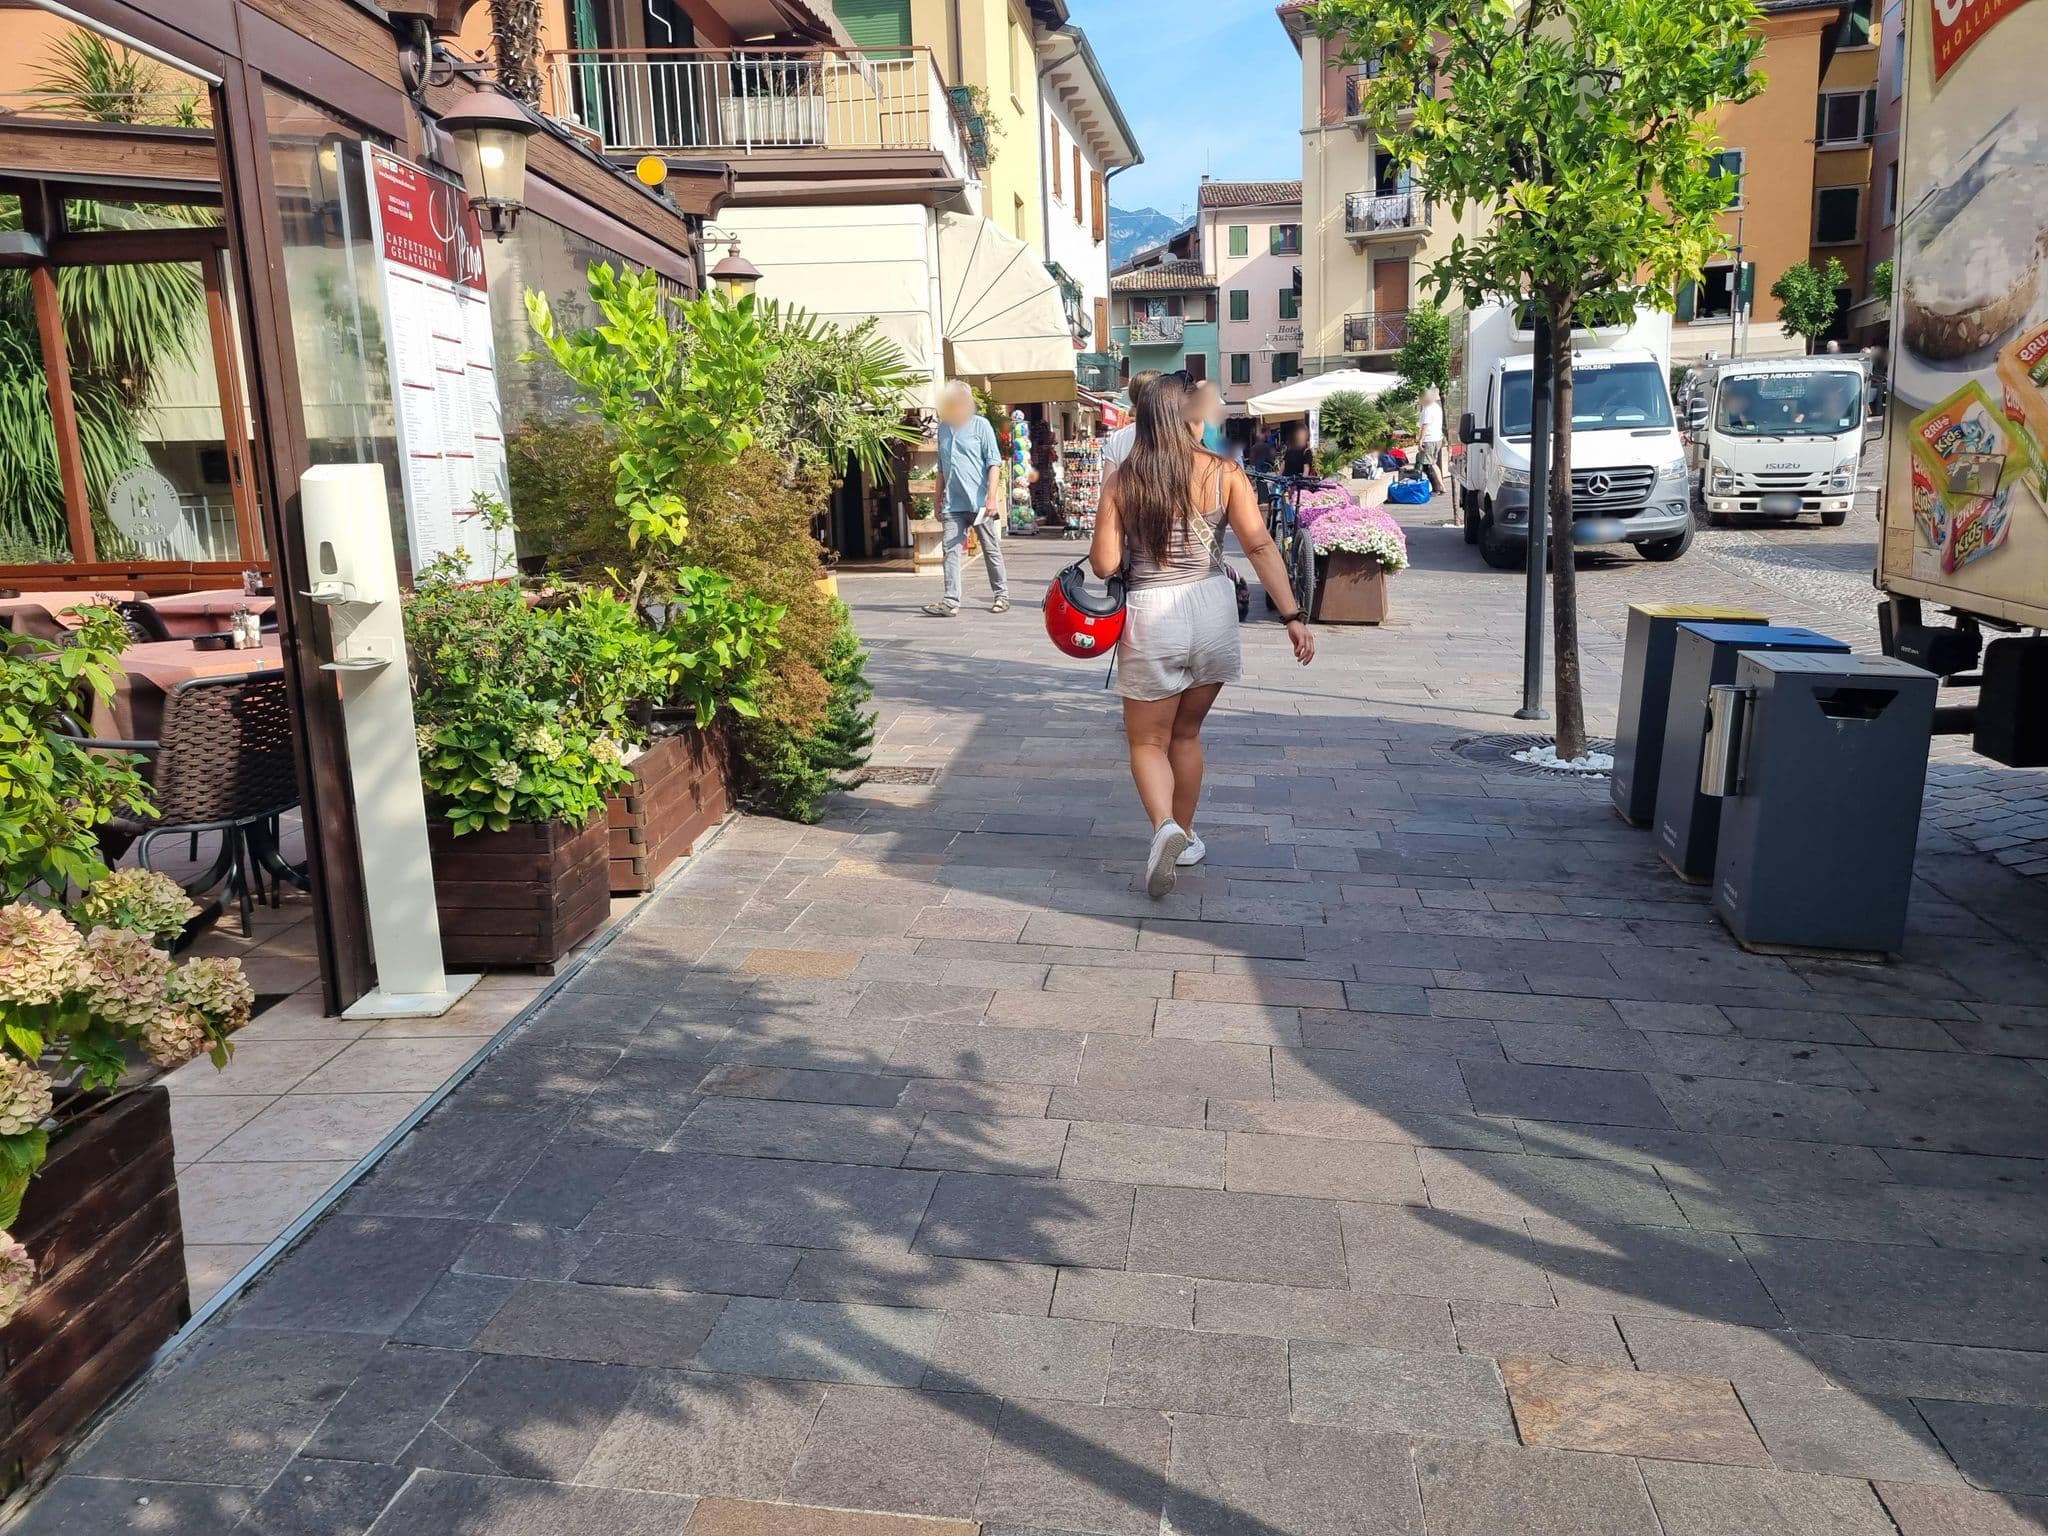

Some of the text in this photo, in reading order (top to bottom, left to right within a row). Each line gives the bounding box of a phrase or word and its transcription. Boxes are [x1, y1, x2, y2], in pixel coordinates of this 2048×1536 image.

[386, 231, 442, 262] CAFFETTERIA
[391, 245, 437, 272] GELATERIA
[1279, 325, 1301, 333] Hotel
[1734, 374, 1769, 382] GRUPPO
[1934, 428, 1962, 452] Kids
[1955, 521, 1983, 559] Kids
